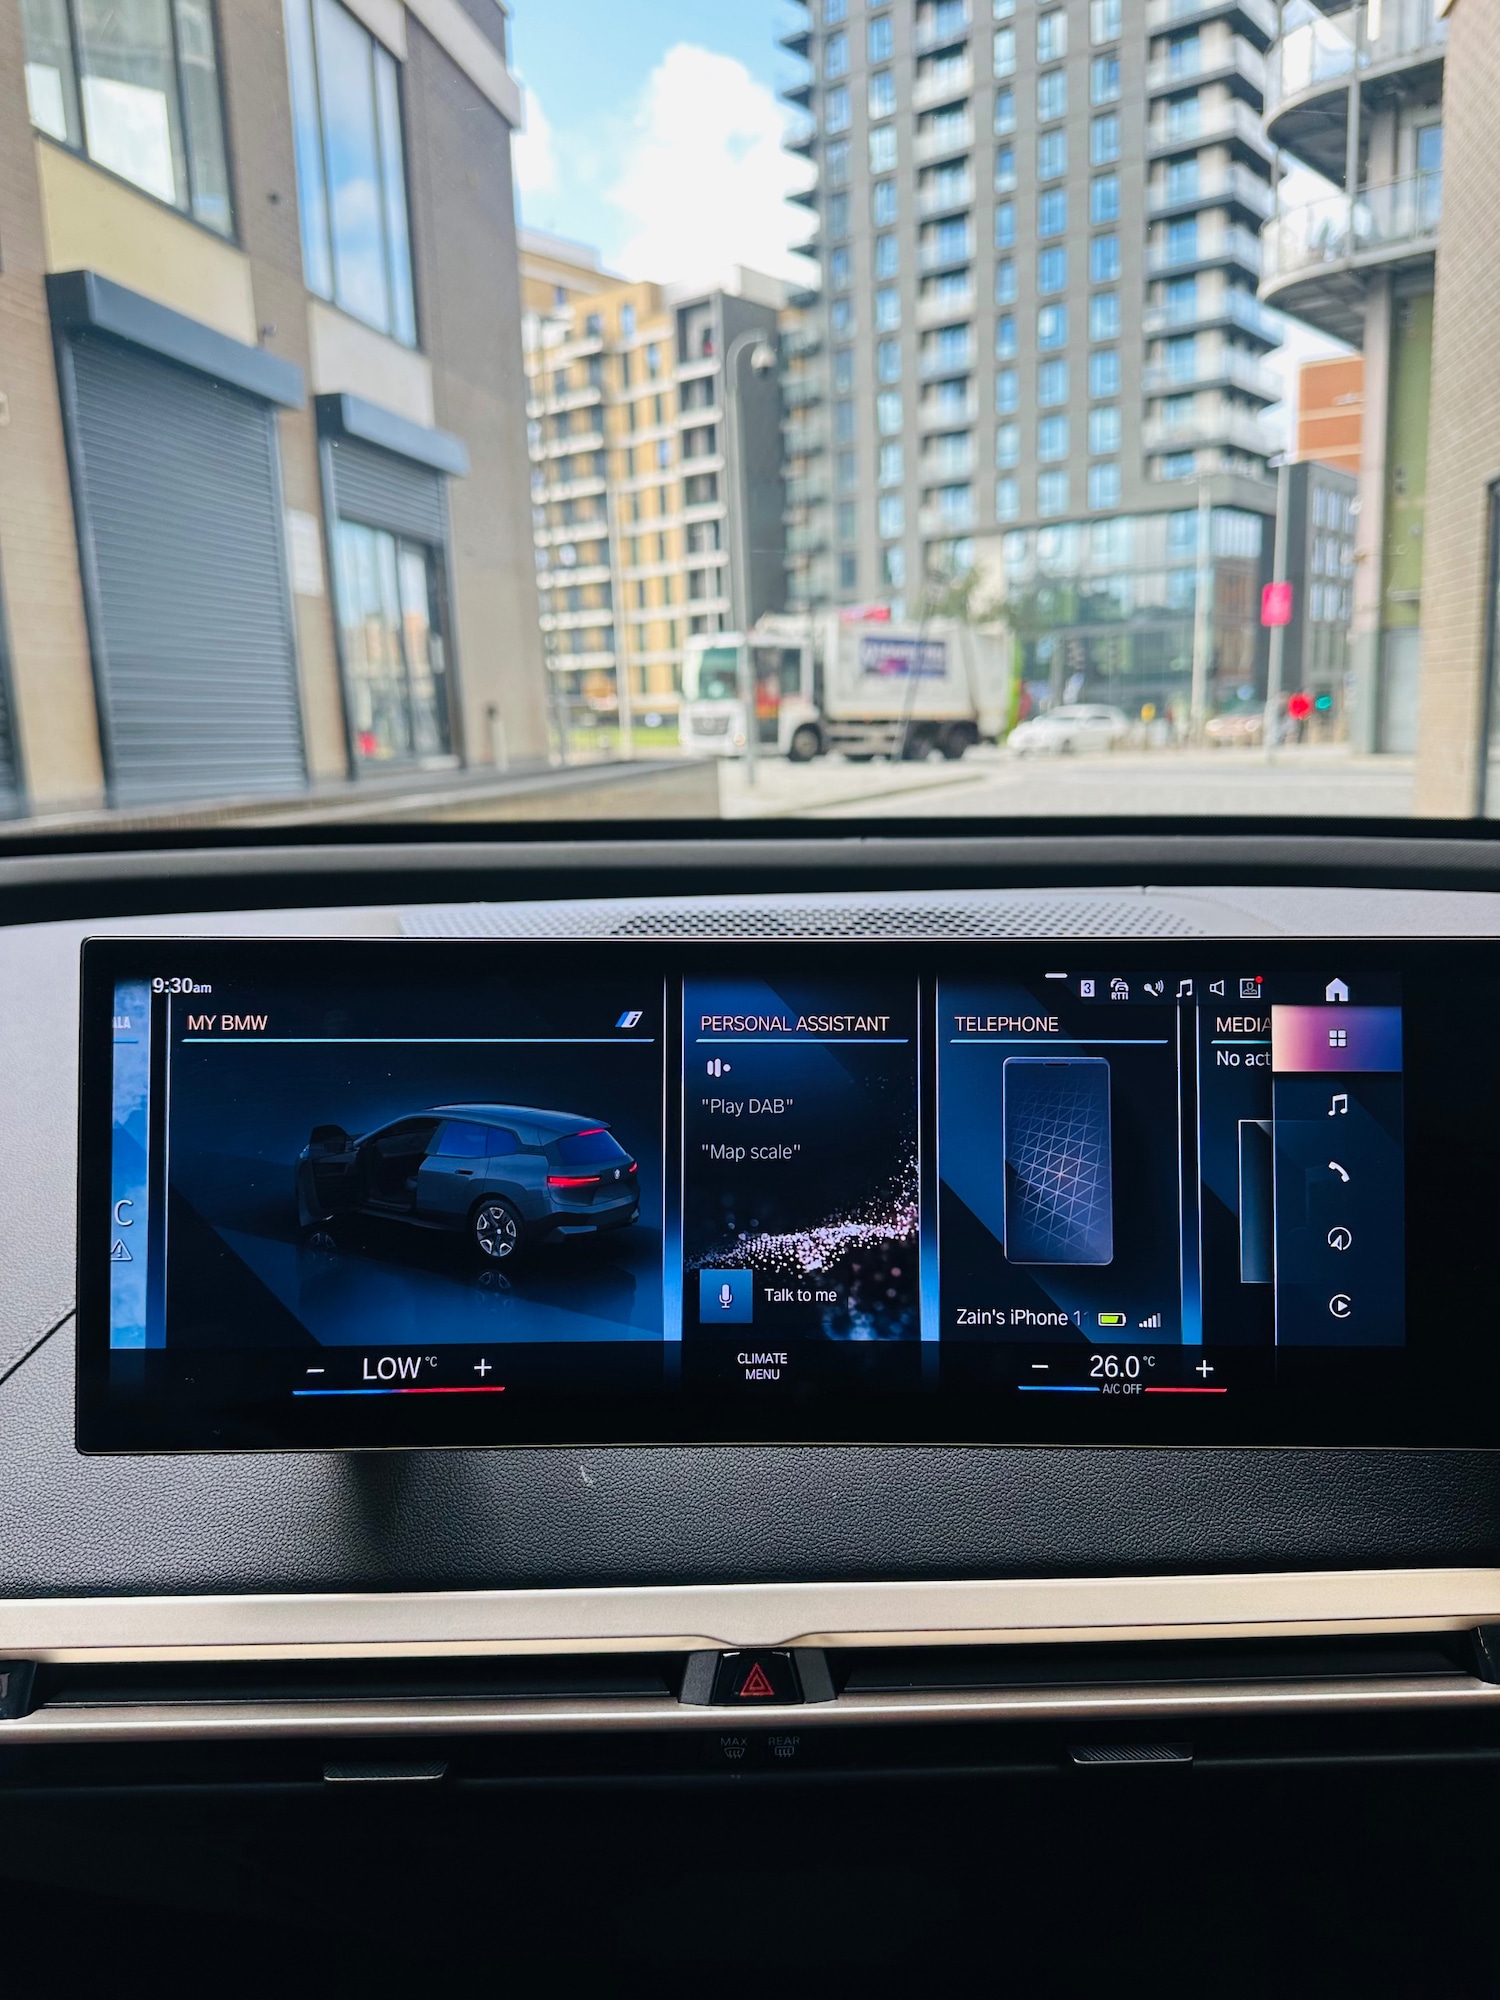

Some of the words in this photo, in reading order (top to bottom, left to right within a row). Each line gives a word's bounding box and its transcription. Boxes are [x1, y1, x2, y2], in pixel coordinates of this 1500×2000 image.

[152, 977, 212, 994] 9:30am
[187, 1014, 217, 1031] MY
[221, 1014, 268, 1031] BMW
[701, 1015, 793, 1032] PERSONAL
[795, 1015, 890, 1032] ASSISTANT
[954, 1016, 1059, 1032] TELEPHONE
[1216, 1016, 1272, 1033] MEDIA
[1216, 1050, 1241, 1067] No
[764, 1288, 795, 1302] Talk
[797, 1289, 812, 1302] to
[815, 1290, 838, 1302] me
[956, 1308, 1006, 1326] Zain's
[1010, 1309, 1069, 1326] iPhone
[737, 1352, 788, 1364] CLIMATE
[1089, 1355, 1140, 1378] 26.0
[362, 1356, 422, 1380] LOW
[745, 1368, 780, 1380] MENU
[1102, 1384, 1120, 1395] A/C
[1122, 1384, 1142, 1395] OFF
[720, 1737, 748, 1746] MAX
[768, 1736, 800, 1746] REAR
